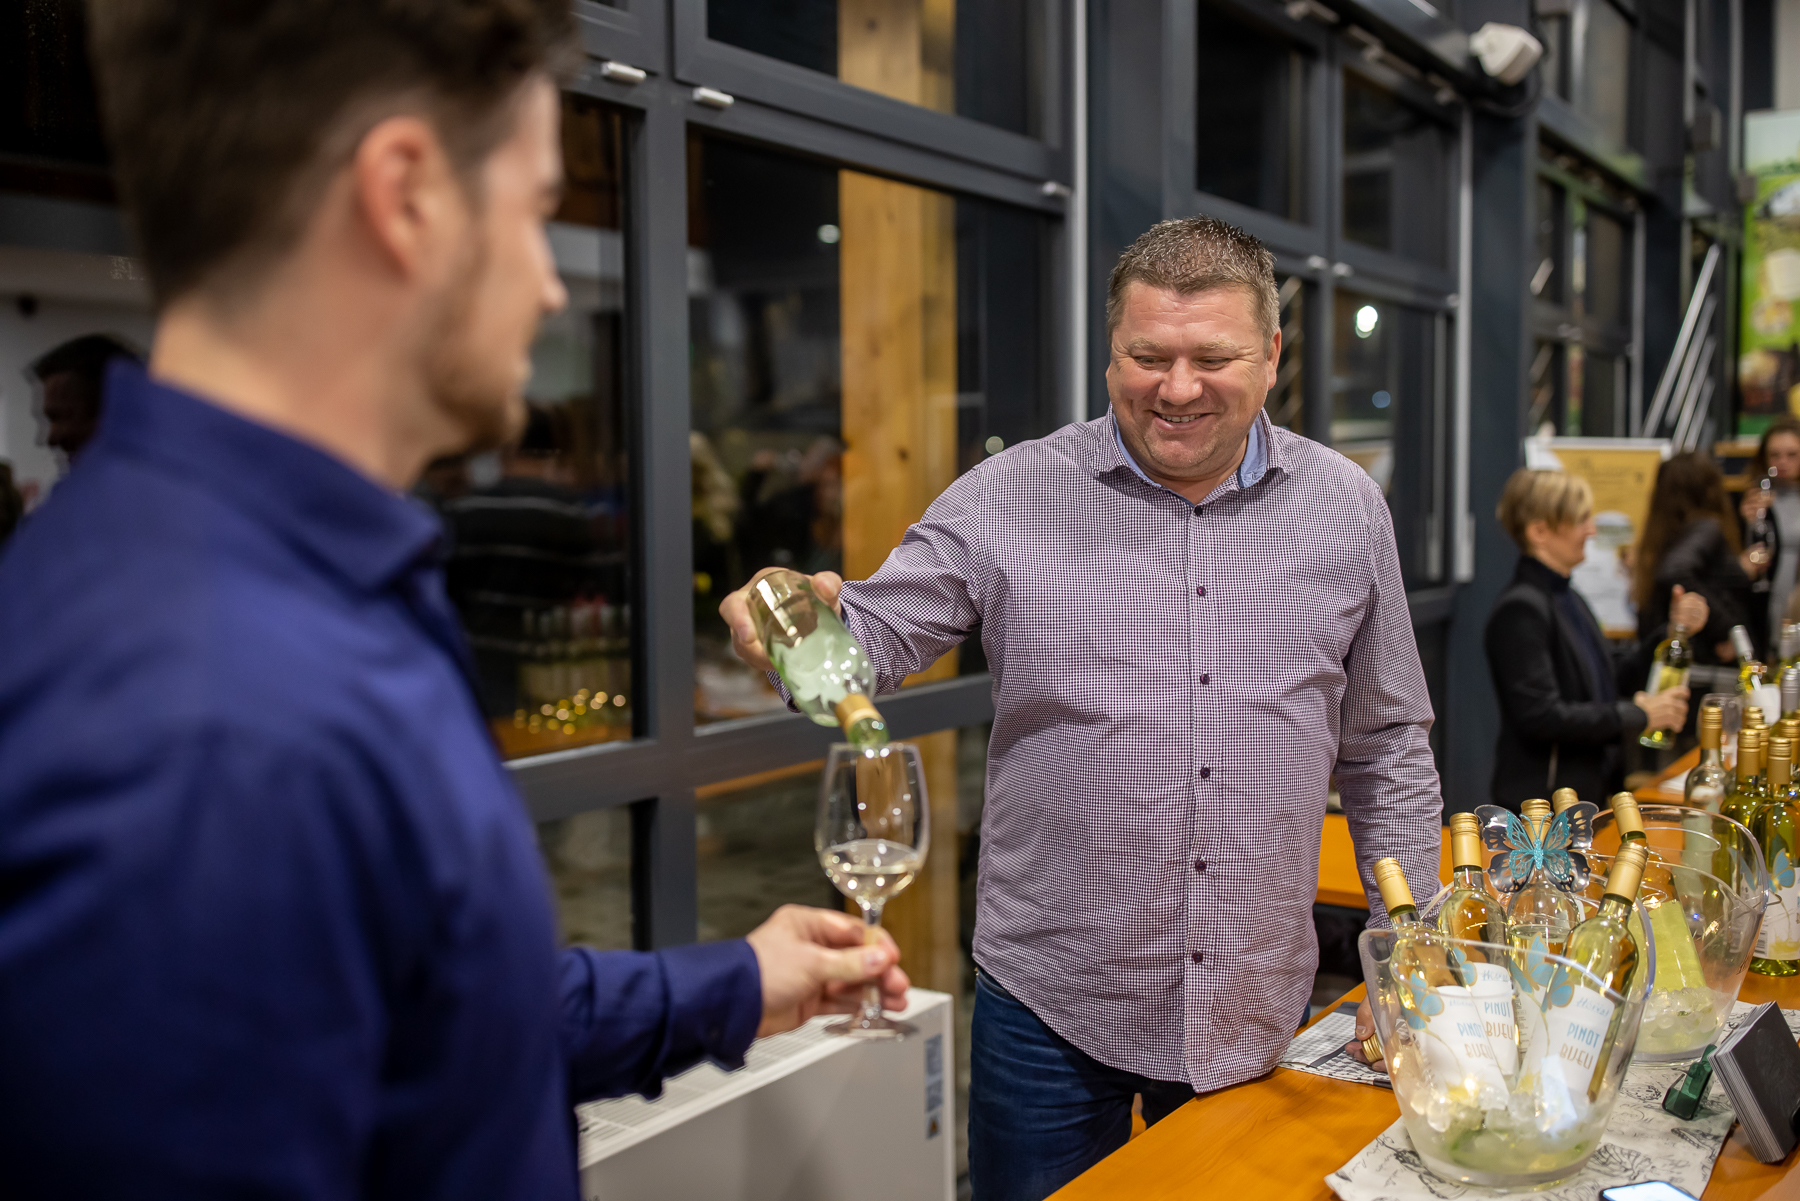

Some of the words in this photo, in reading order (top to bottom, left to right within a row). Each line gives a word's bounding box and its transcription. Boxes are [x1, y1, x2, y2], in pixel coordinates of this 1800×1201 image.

[1484, 1001, 1511, 1018] PINOT
[1456, 1022, 1485, 1039] PINOT
[1566, 1022, 1601, 1049] PINOT
